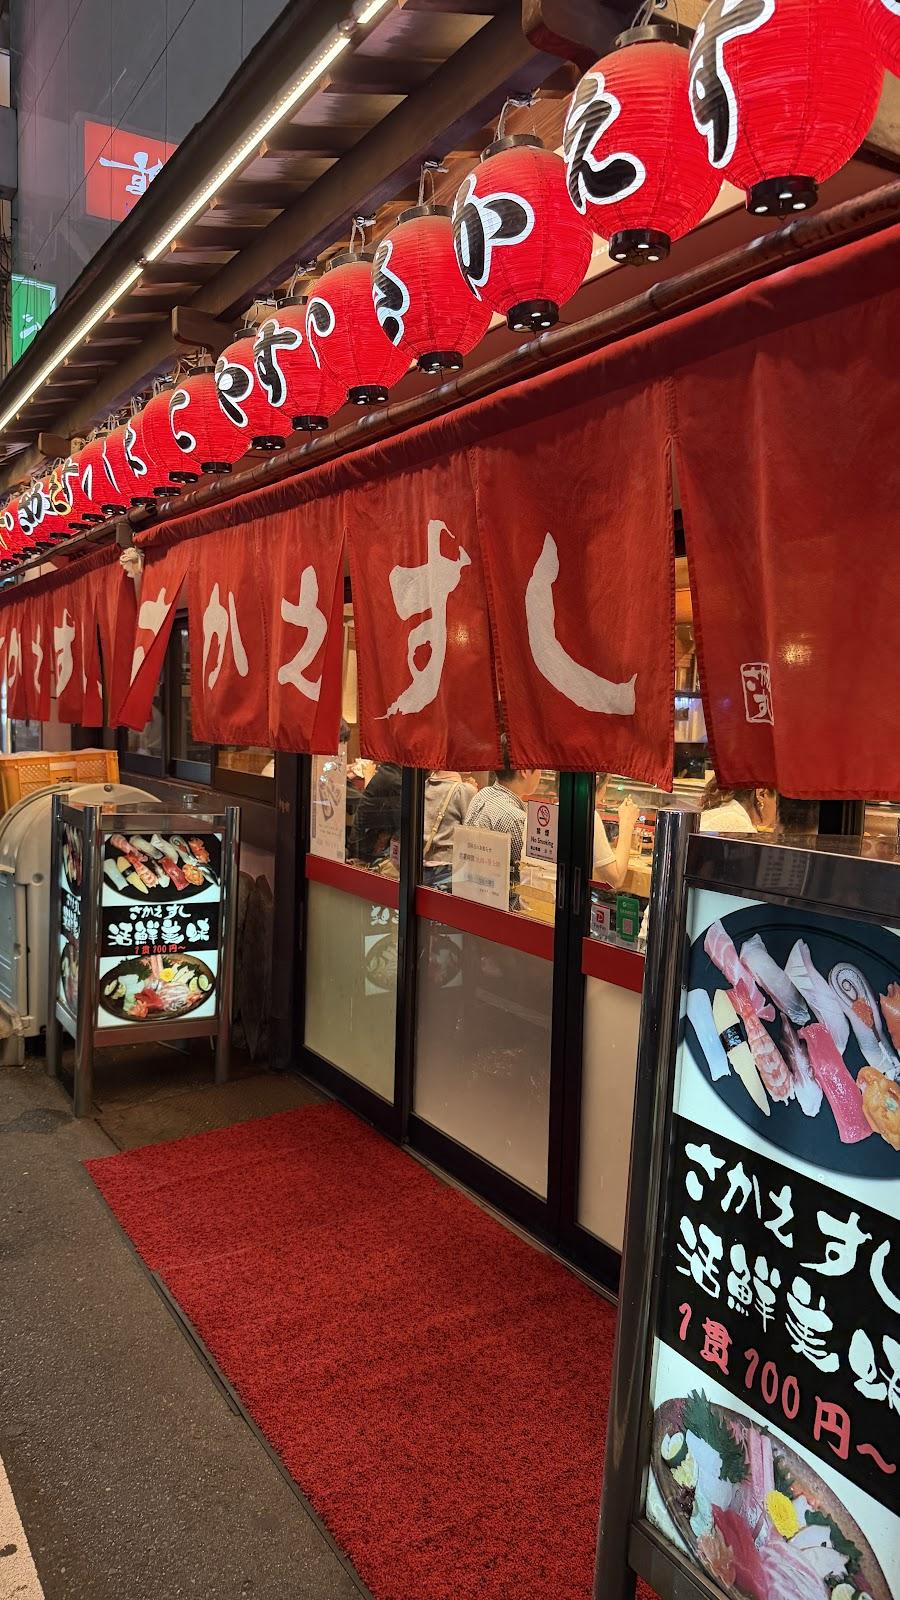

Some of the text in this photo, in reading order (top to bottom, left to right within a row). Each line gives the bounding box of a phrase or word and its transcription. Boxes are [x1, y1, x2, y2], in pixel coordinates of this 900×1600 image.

[537, 837, 554, 849] Smoking
[107, 918, 210, 946] 活鮮美味
